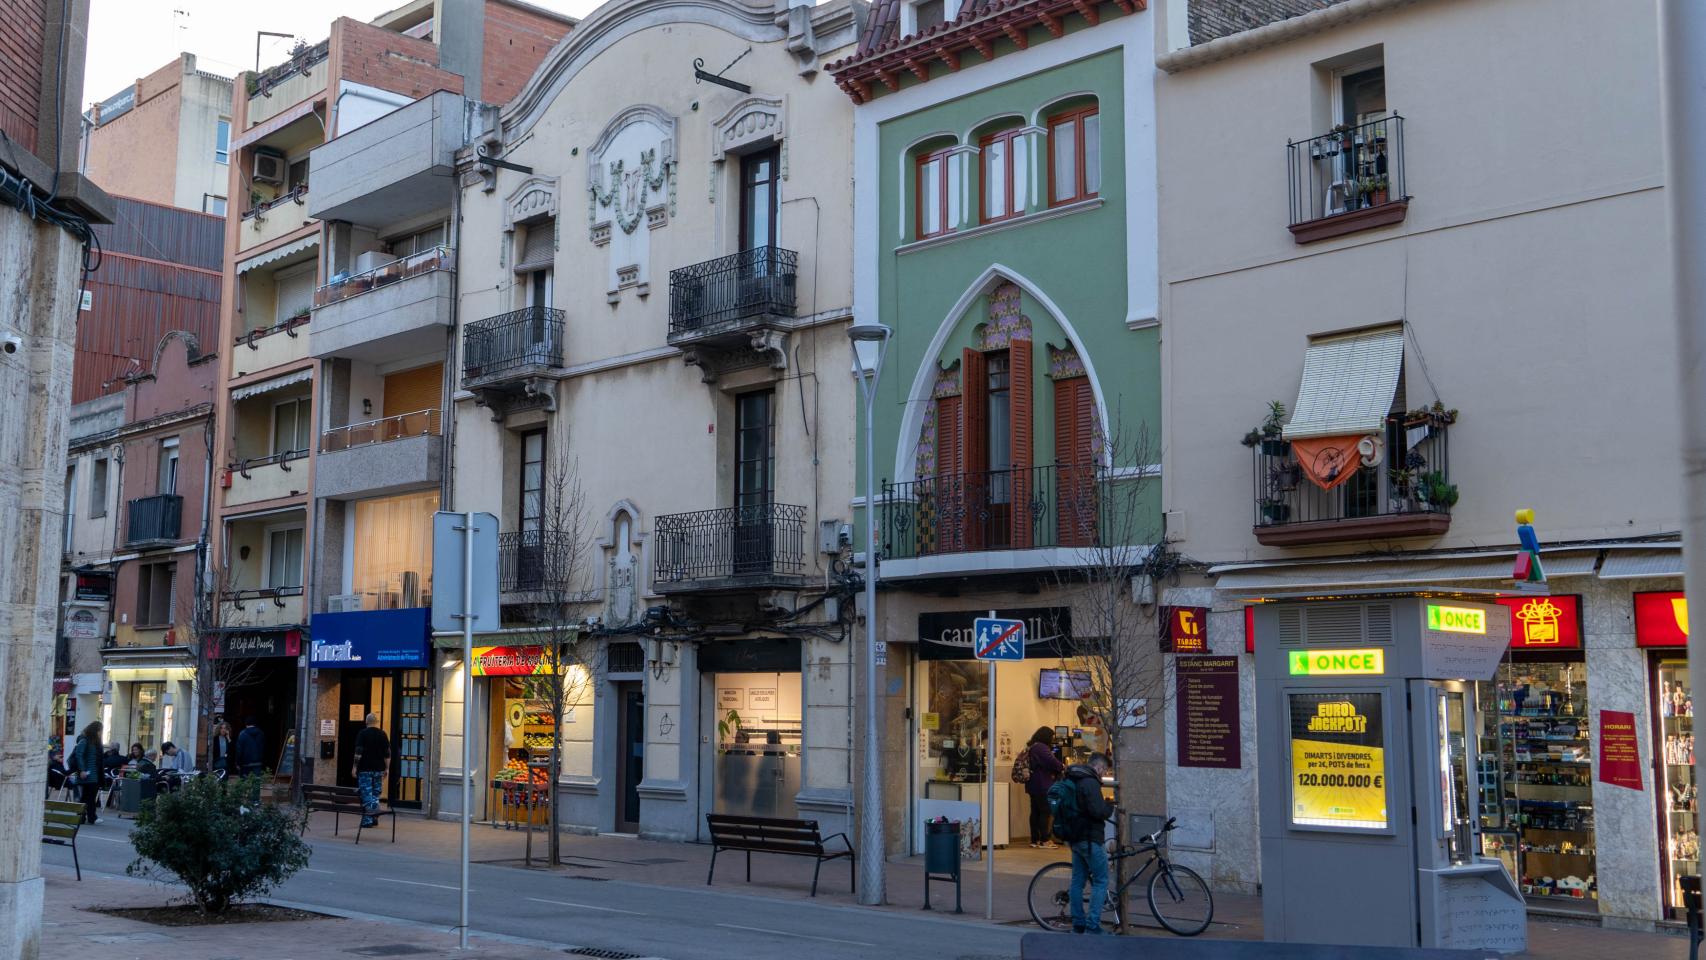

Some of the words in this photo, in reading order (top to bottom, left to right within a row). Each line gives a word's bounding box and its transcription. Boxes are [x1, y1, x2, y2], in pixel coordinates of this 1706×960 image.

[1445, 611, 1481, 629] ONCE
[1176, 638, 1202, 646] TABACS
[516, 655, 525, 667] DE
[1203, 660, 1235, 668] MARGARIT
[1317, 654, 1376, 670] ONCE
[1318, 701, 1354, 717] EURO
[1308, 715, 1365, 733] JACKPOT
[1304, 752, 1332, 760] DIMARTS
[1336, 753, 1374, 761] DIVENDRES,
[1354, 761, 1365, 769] fins
[1298, 773, 1371, 788] 120.000.000
[1373, 775, 1383, 788] €
